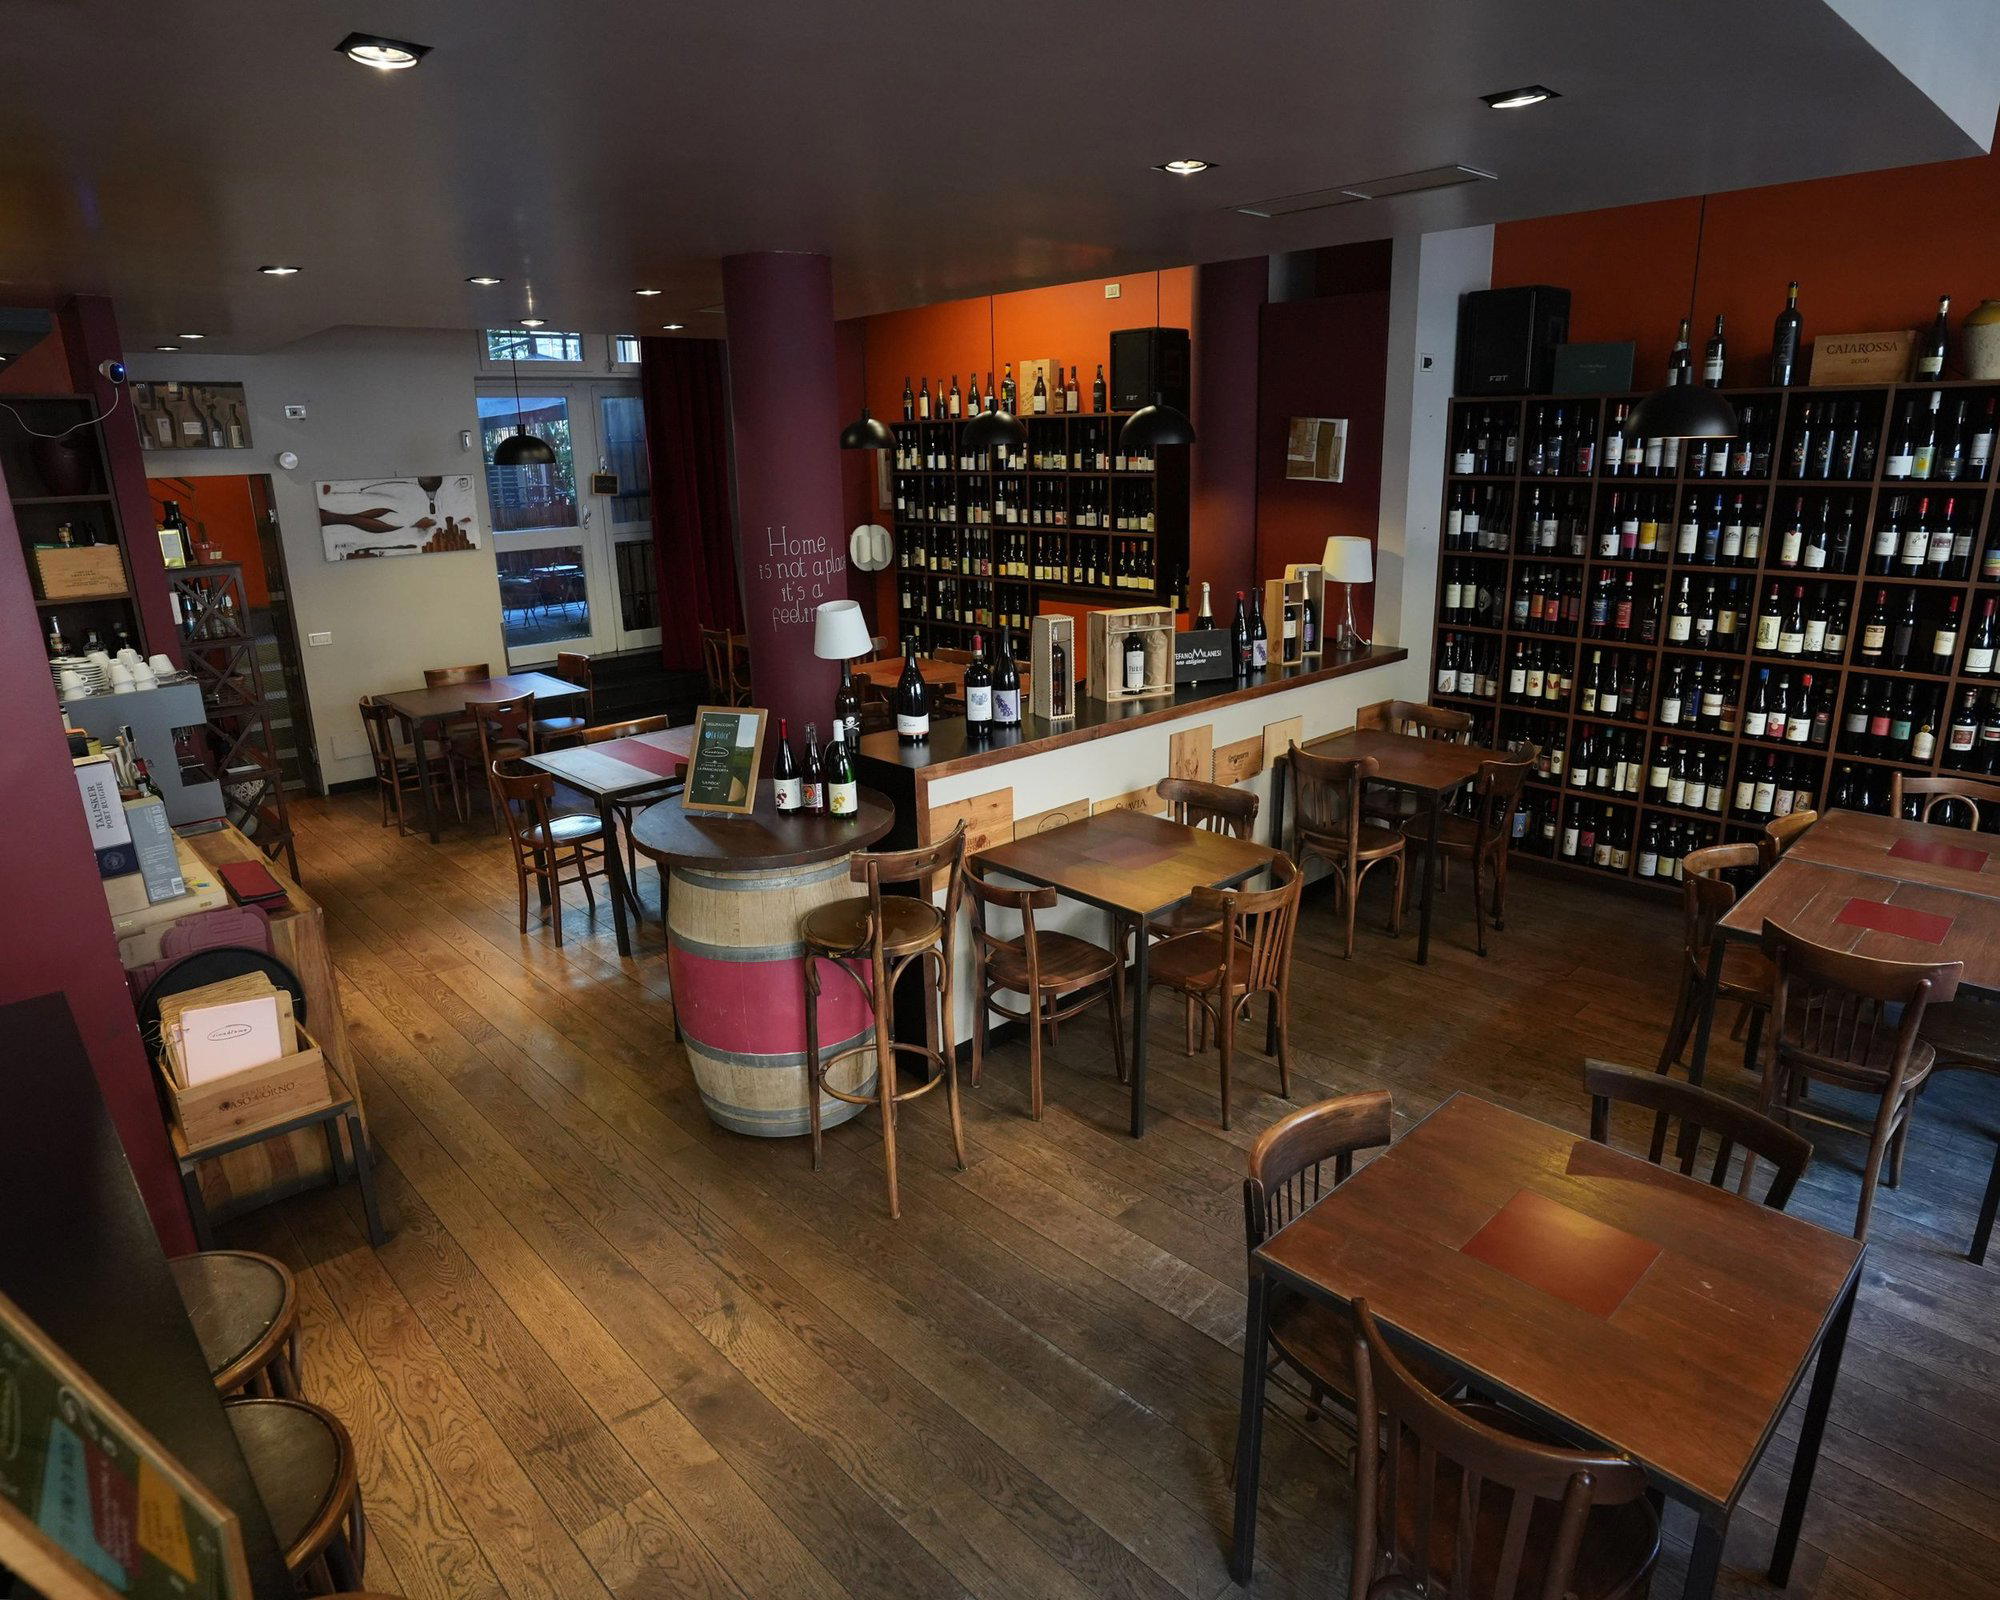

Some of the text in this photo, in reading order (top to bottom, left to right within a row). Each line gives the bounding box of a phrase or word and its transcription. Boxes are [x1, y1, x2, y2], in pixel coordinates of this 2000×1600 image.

[1826, 340, 1898, 355] CAIAROSSA
[767, 525, 826, 557] Home
[759, 563, 773, 580] is
[776, 556, 807, 579] not
[812, 560, 824, 577] a
[781, 581, 824, 602] it's a
[771, 599, 818, 633] feelin
[1174, 651, 1193, 660] EFANO
[87, 785, 105, 830] TALISKER
[95, 781, 114, 830] PORT RUIGHE
